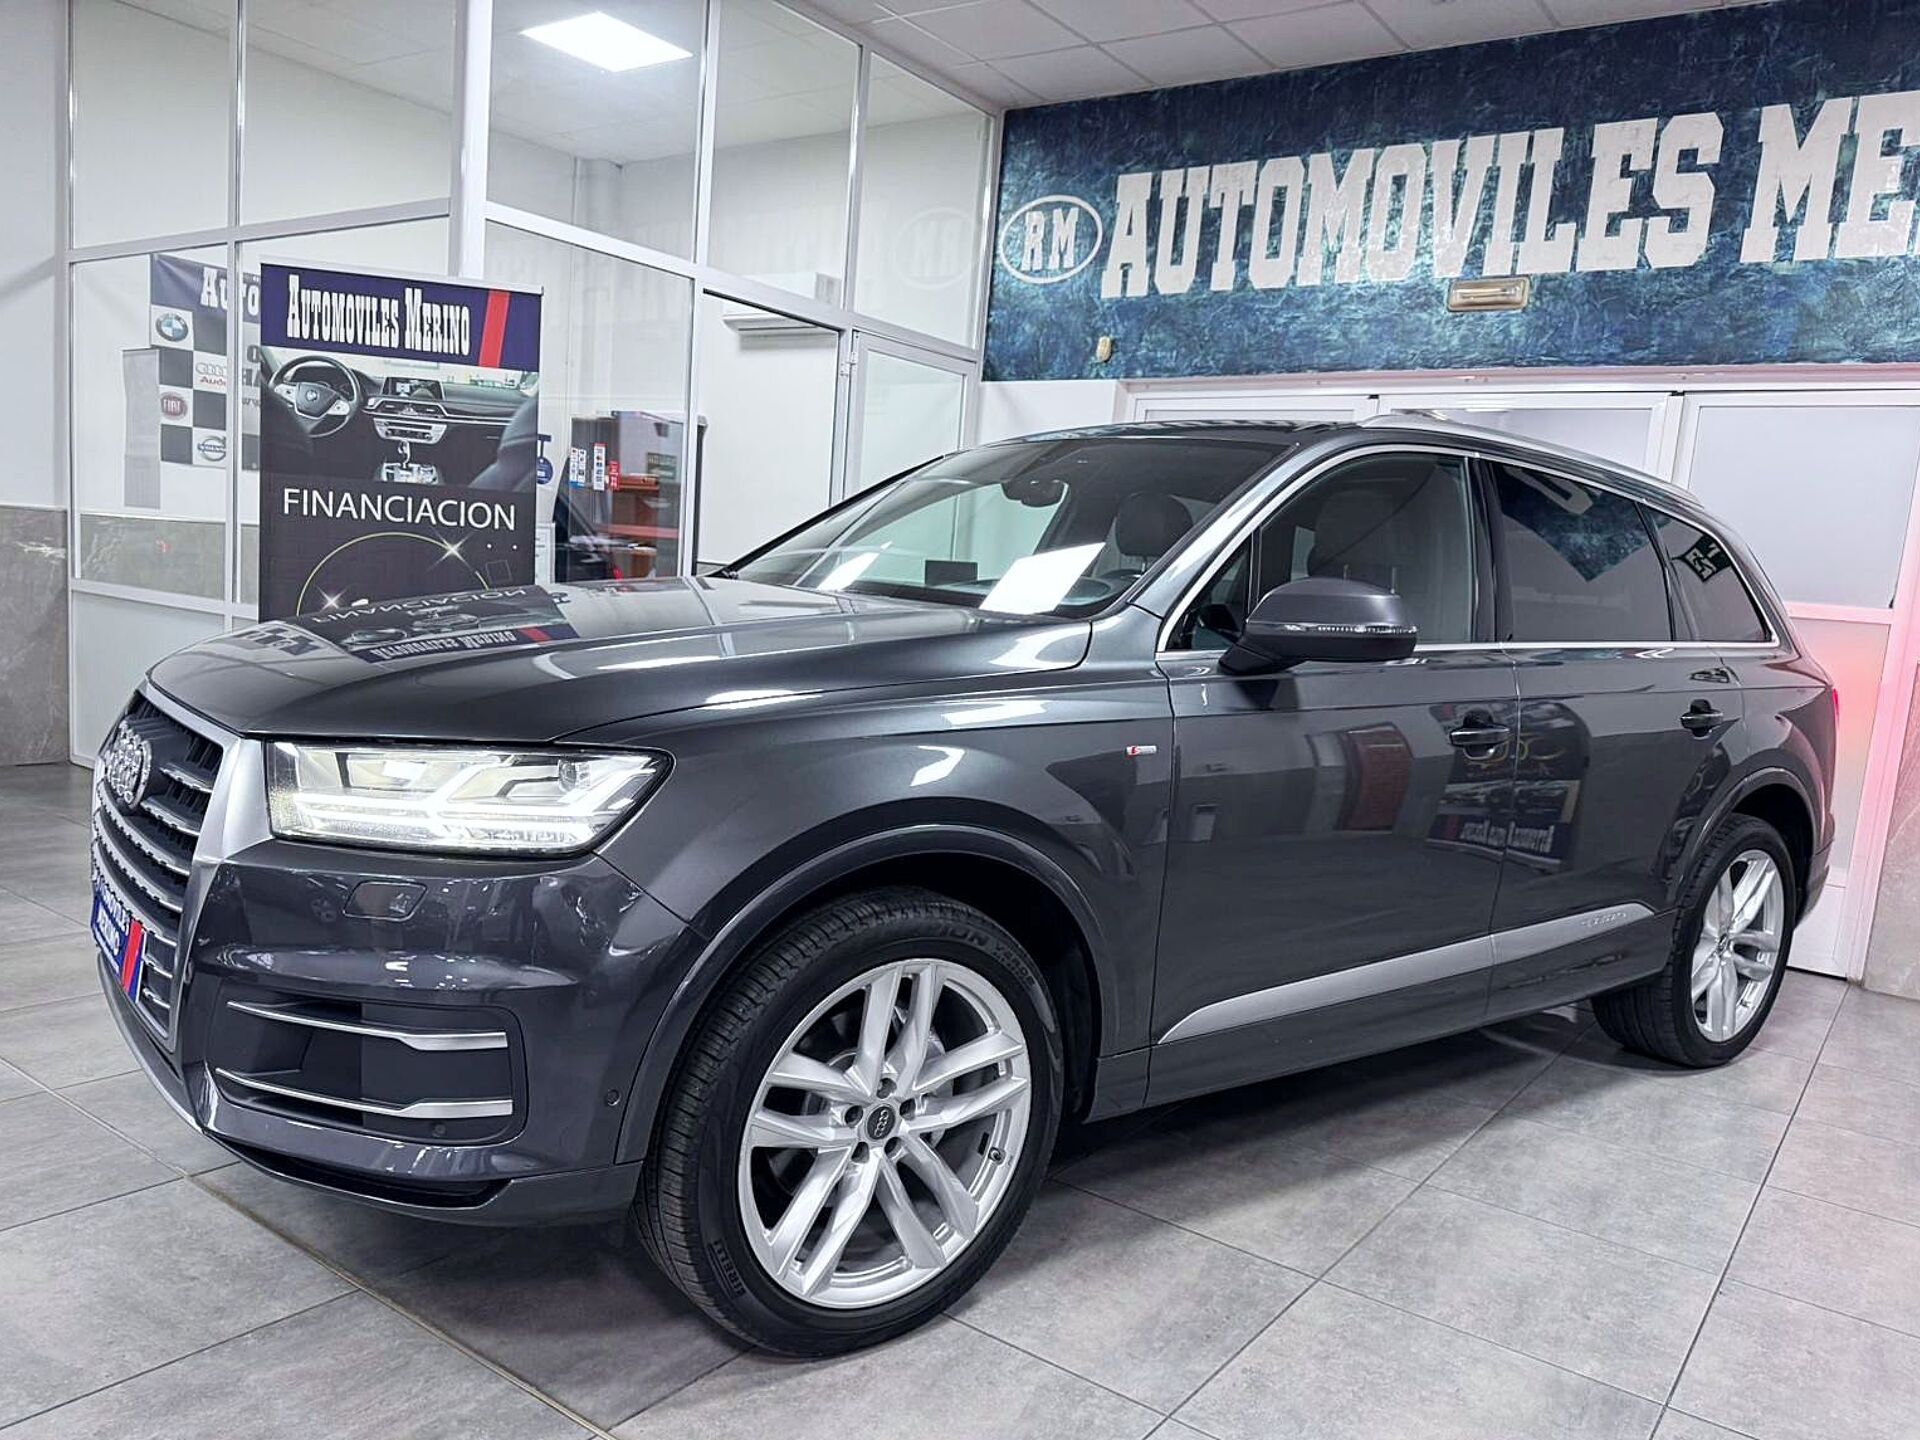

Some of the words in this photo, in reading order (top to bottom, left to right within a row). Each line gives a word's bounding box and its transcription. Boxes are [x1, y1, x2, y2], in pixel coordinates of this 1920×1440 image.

[1101, 112, 1724, 299] AUTOMOVILES
[1739, 90, 1920, 263] ME
[1021, 207, 1078, 271] RM
[283, 488, 516, 530] FINANCIACION
